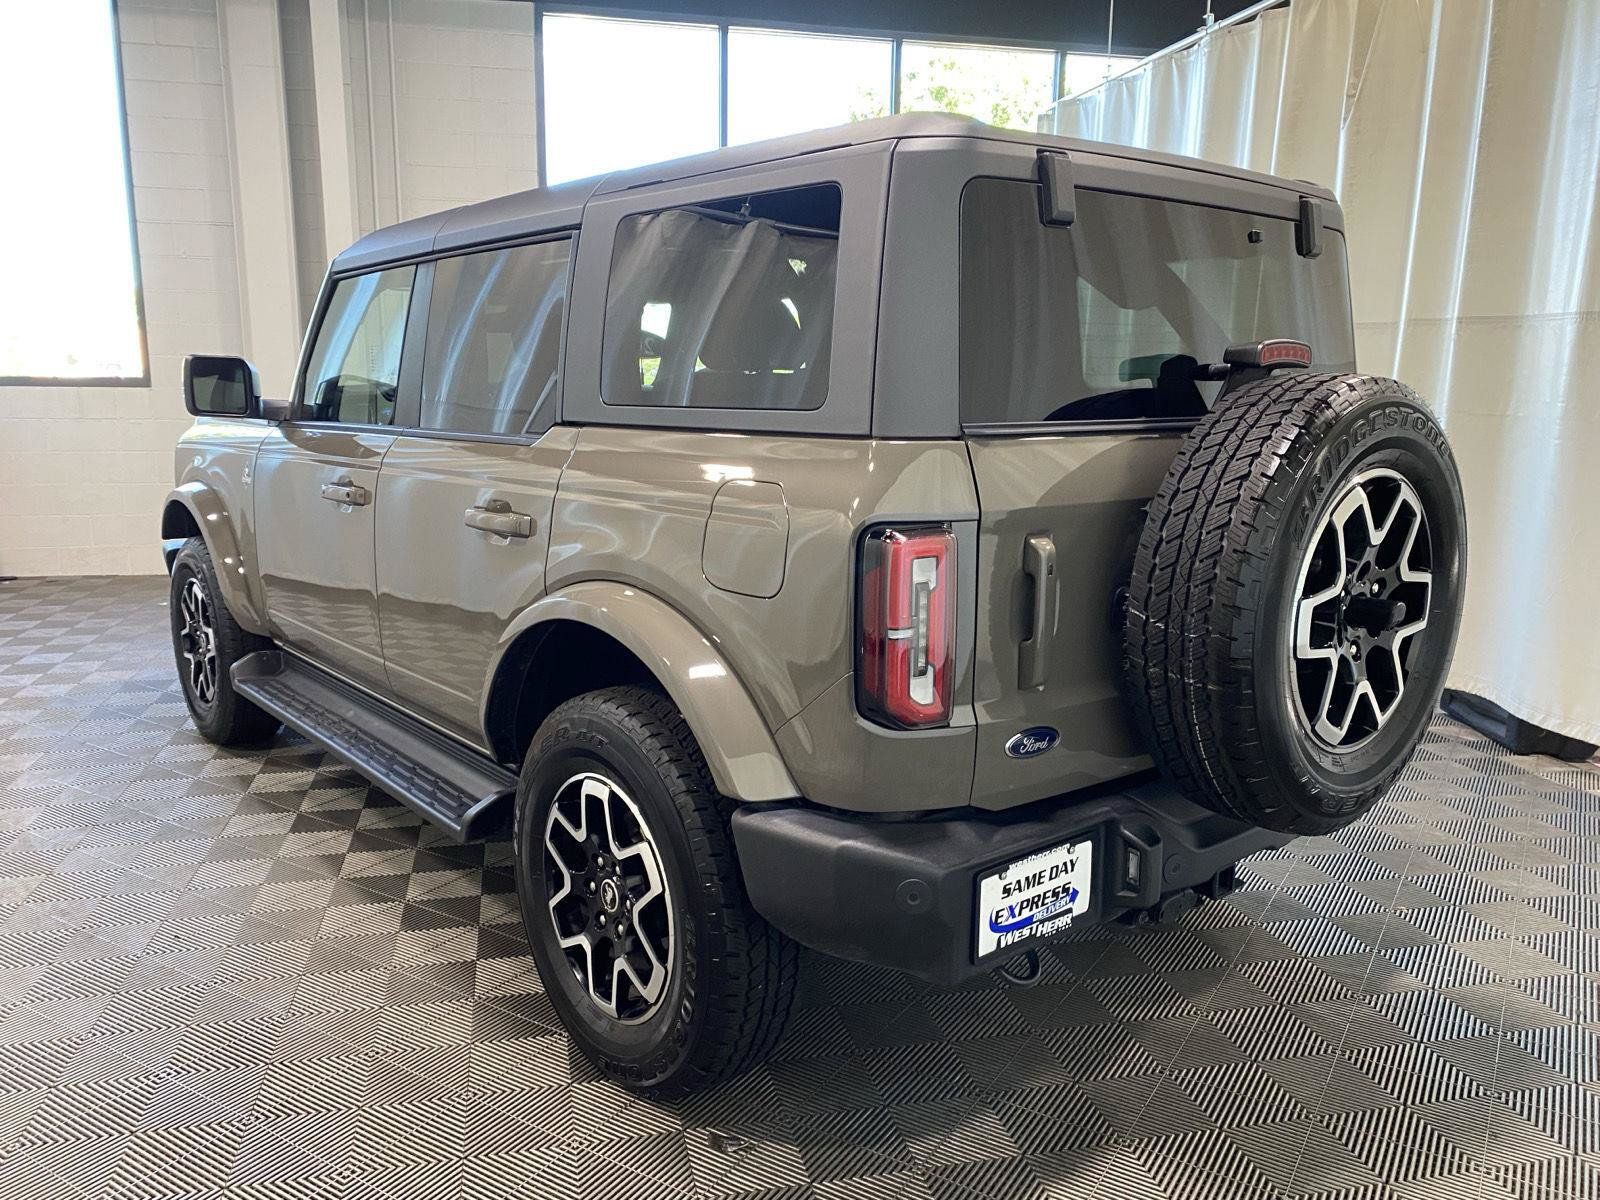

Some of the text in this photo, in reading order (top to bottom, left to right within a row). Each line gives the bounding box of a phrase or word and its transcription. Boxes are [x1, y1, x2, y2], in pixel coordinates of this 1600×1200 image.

[1019, 736, 1050, 754] Ford
[1001, 856, 1080, 900] SAME DAY
[994, 881, 1072, 925] EXPRESS
[1033, 896, 1071, 922] DELIVERY
